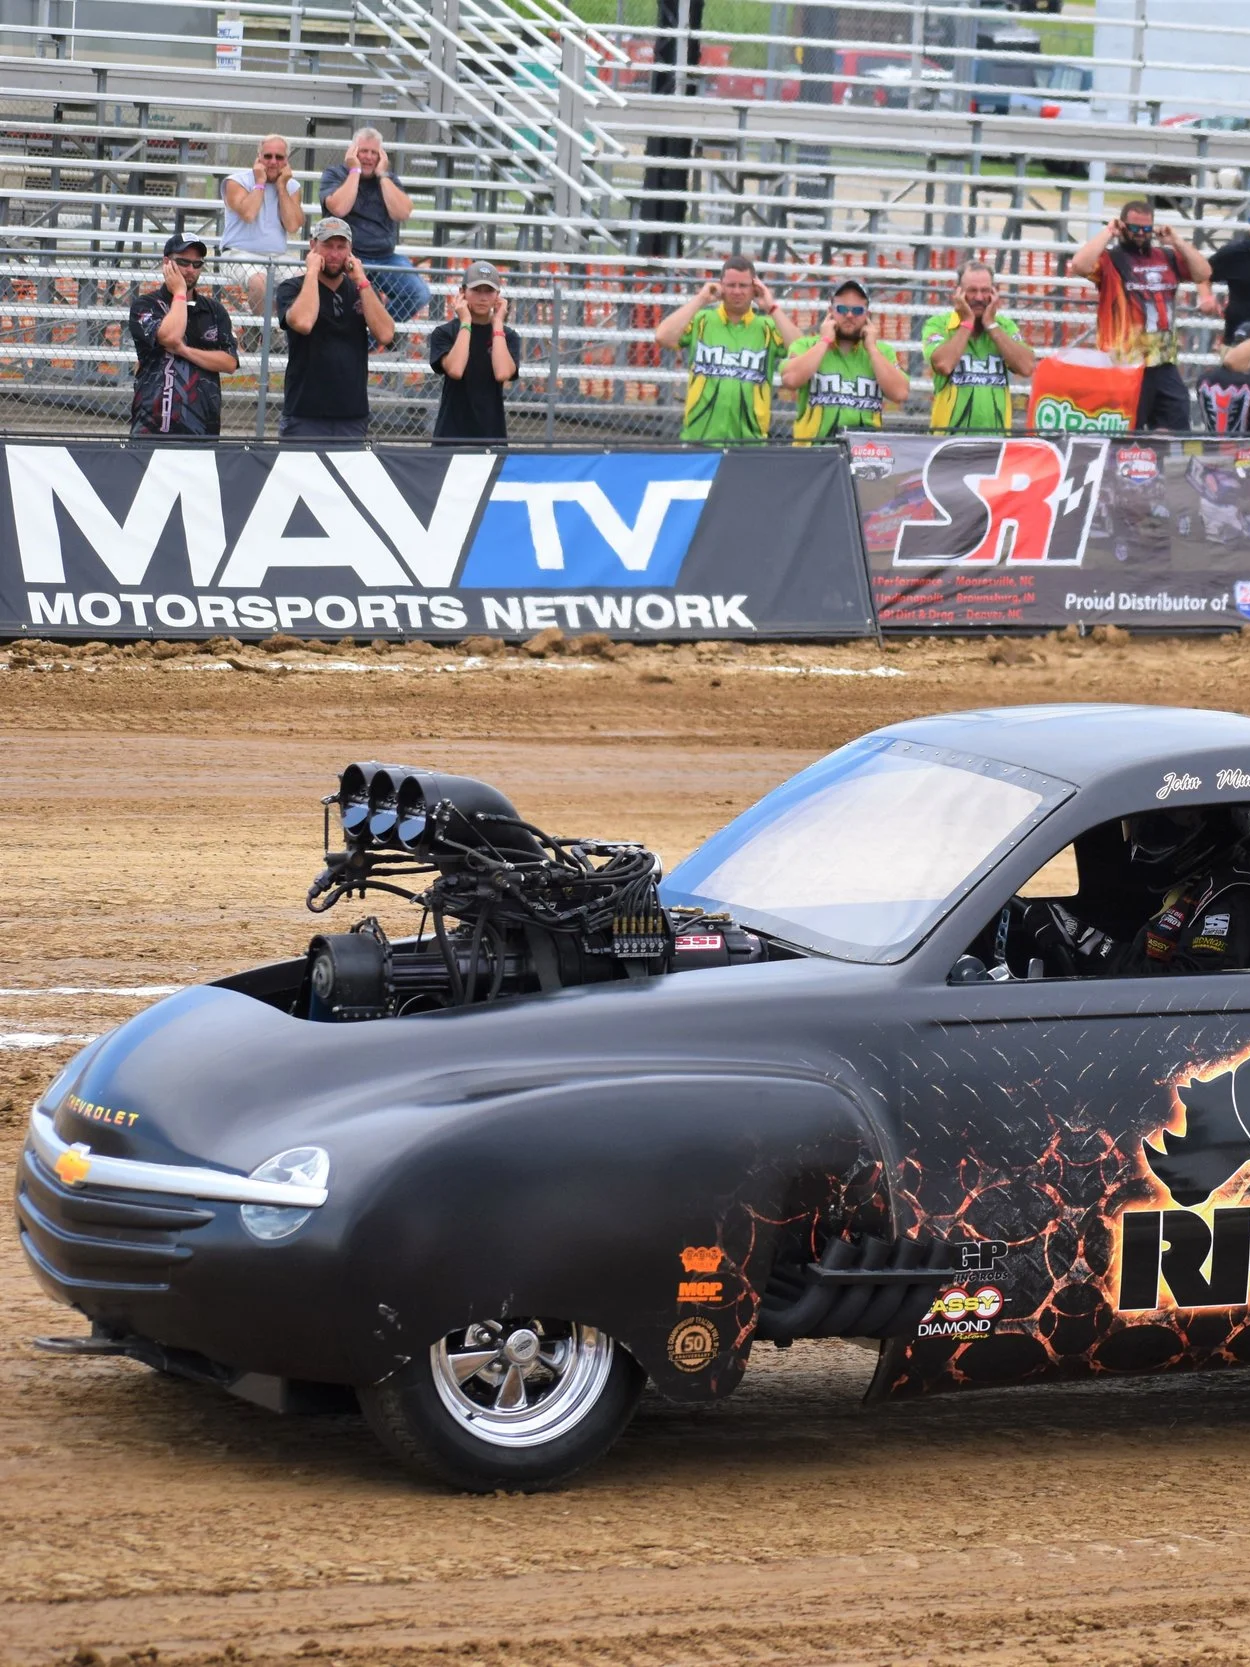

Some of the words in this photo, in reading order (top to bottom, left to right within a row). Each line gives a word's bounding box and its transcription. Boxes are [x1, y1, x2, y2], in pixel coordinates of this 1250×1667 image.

[893, 437, 1111, 567] SRI
[27, 591, 468, 629] MOTORSPORTS
[481, 594, 757, 630] NETWORK
[1065, 592, 1115, 610] Proud
[1118, 592, 1207, 611] Distributor
[1210, 593, 1229, 610] of
[1156, 771, 1202, 799] John
[918, 1320, 991, 1336] DIAMOND
[685, 1336, 706, 1352] 50
